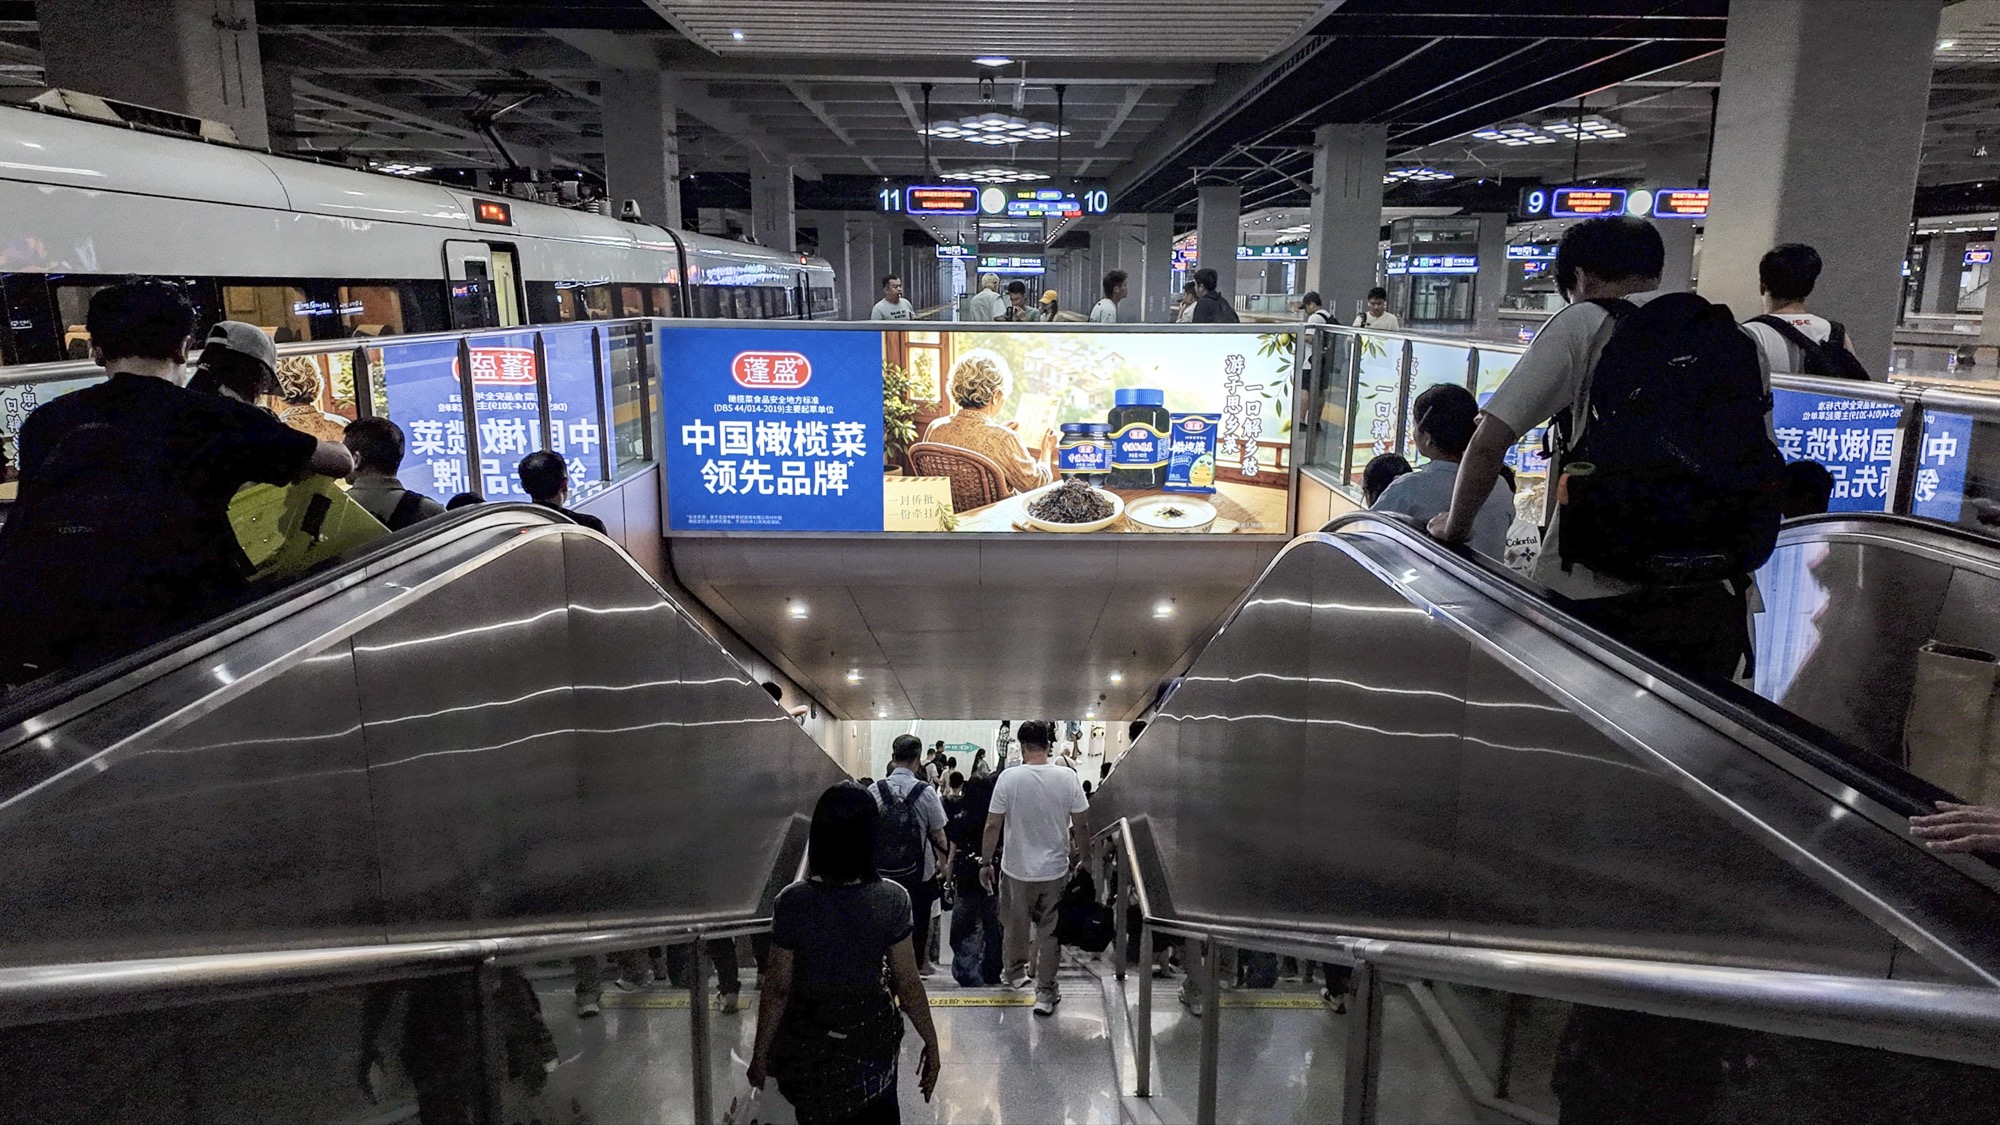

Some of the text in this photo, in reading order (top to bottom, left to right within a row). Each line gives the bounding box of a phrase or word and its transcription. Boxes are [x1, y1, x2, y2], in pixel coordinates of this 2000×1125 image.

[879, 189, 900, 211] 11
[1084, 190, 1108, 212] 10
[1528, 191, 1544, 213] 9
[743, 357, 799, 384] 蓬盛
[1223, 354, 1245, 455] 游子思乡菜
[681, 418, 867, 458] 中国橄榄菜
[1241, 384, 1264, 477] 一口解乡愁
[1505, 536, 1538, 547] Colorful
